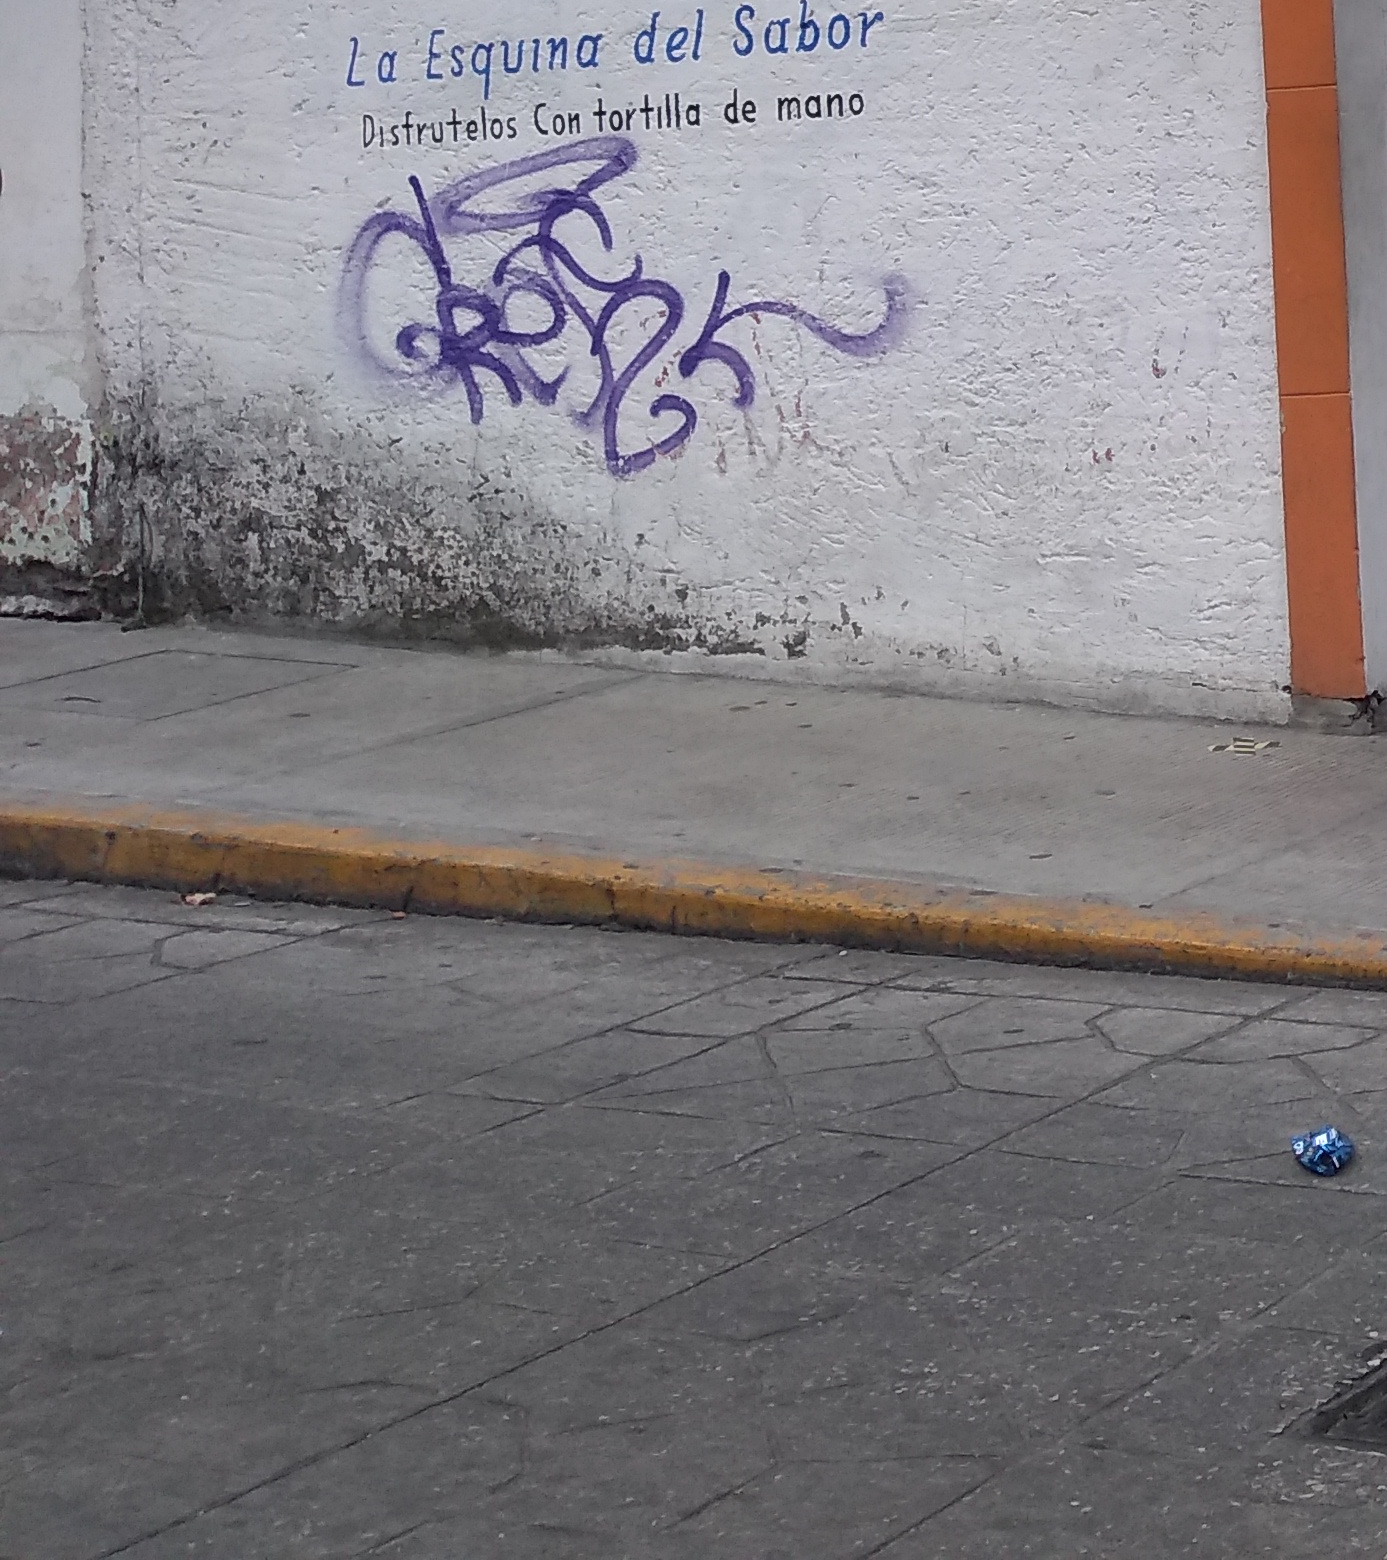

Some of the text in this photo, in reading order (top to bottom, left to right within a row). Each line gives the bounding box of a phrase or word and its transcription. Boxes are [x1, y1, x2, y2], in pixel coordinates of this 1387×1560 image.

[346, 36, 398, 87] La
[426, 28, 604, 100] Esquina
[633, 9, 705, 66] del
[362, 88, 865, 149] Disfrutelos Con tortilla de mano
